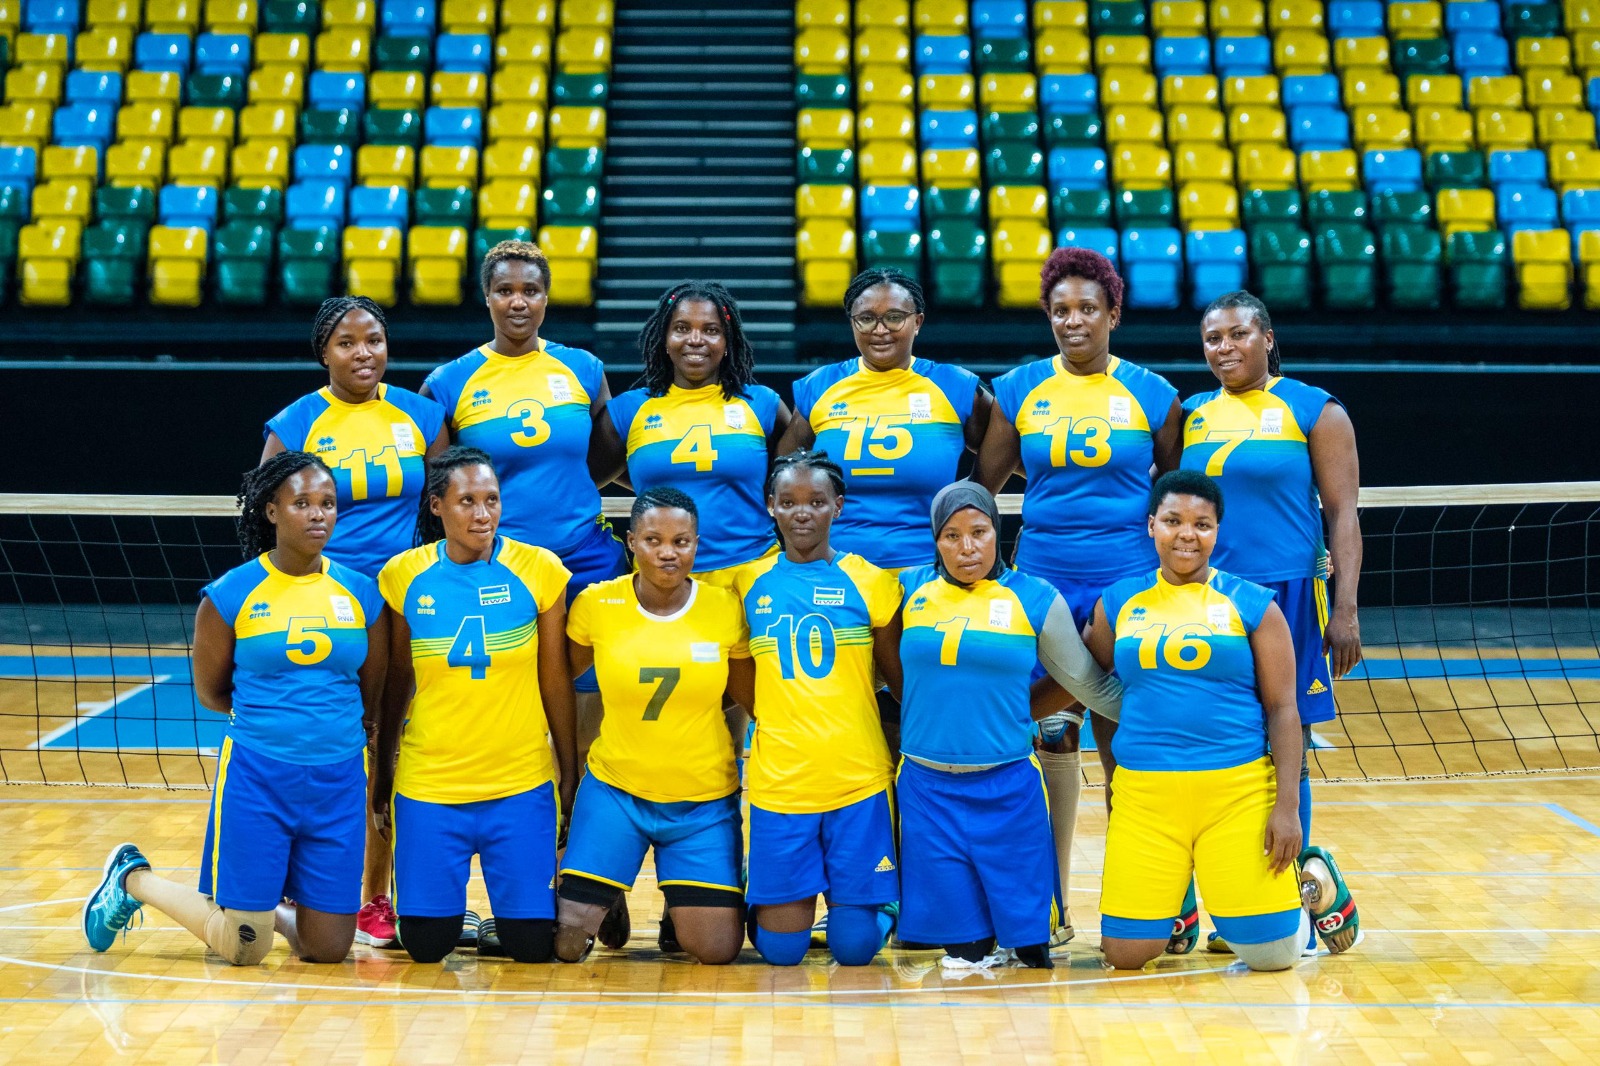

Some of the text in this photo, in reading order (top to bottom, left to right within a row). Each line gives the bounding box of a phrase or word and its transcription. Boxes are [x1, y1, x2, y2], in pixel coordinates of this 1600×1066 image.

[506, 398, 551, 448] 3
[841, 413, 914, 461] 15
[911, 411, 930, 419] RWA
[1110, 416, 1129, 424] RWA
[1261, 426, 1280, 434] RWA
[670, 424, 719, 472] 4
[1043, 416, 1112, 468] 13
[1204, 429, 1254, 477] 7
[340, 445, 404, 501] 11
[285, 616, 333, 666] 5
[447, 615, 492, 680] 4
[766, 613, 836, 680] 10
[934, 616, 970, 666] 1
[1132, 622, 1212, 671] 16
[638, 667, 681, 722] 7
[1307, 686, 1328, 695] adidas
